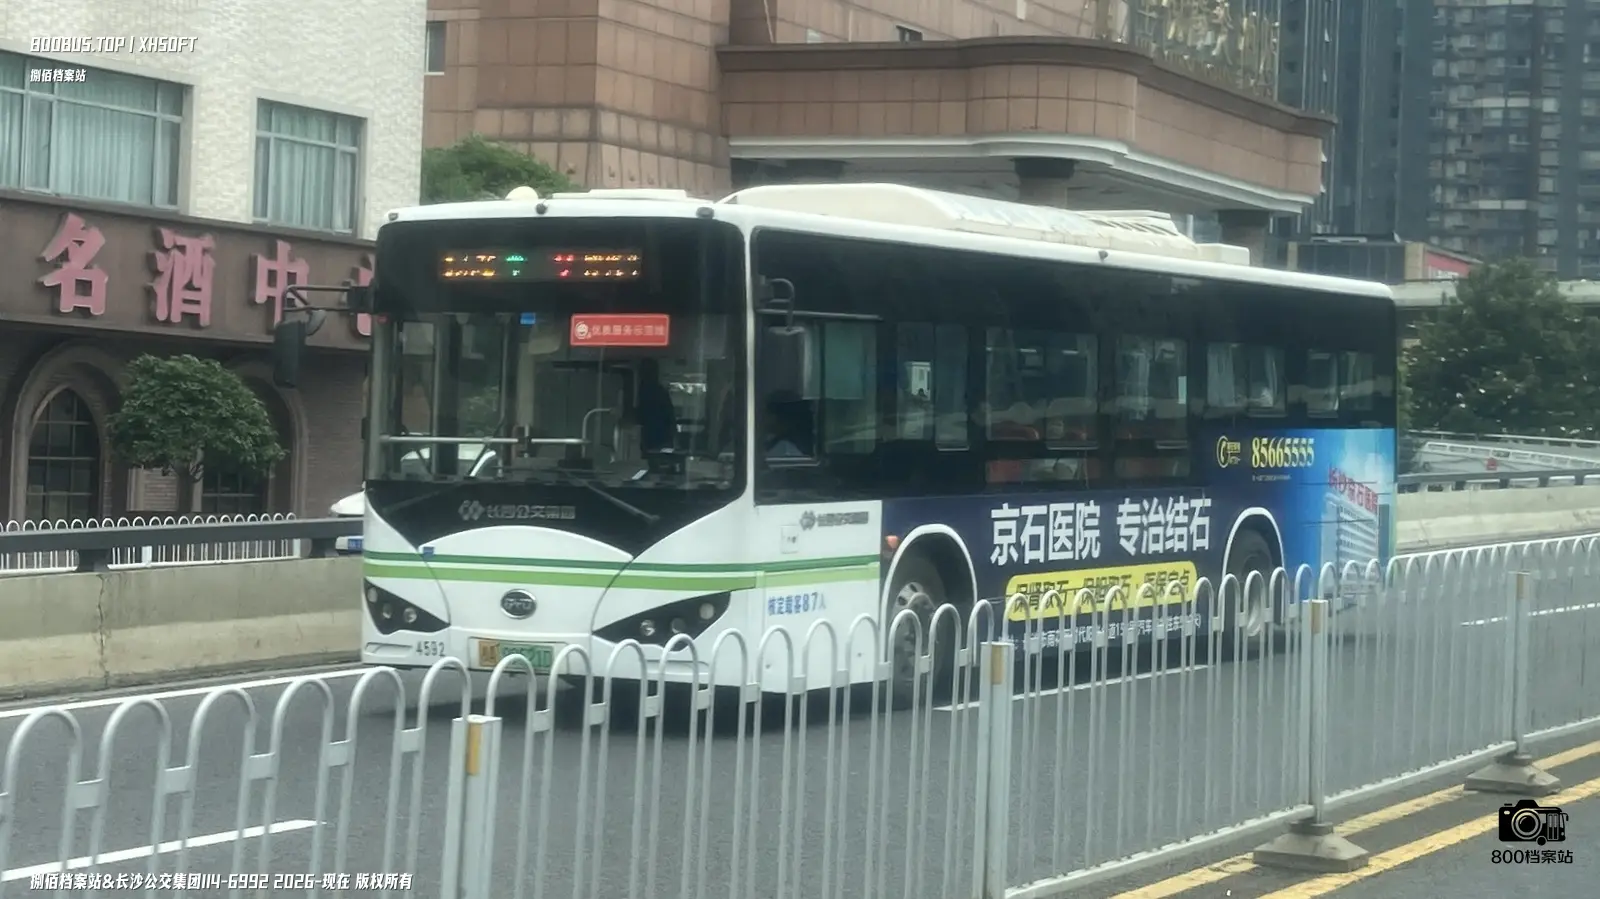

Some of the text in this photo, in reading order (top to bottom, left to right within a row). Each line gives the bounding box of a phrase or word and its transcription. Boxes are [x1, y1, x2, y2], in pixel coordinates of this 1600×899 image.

[37, 212, 373, 336] 名酒中
[1252, 437, 1315, 468] 85665555
[990, 495, 1212, 566] 京石医院 专治结石
[416, 640, 446, 657] 4592
